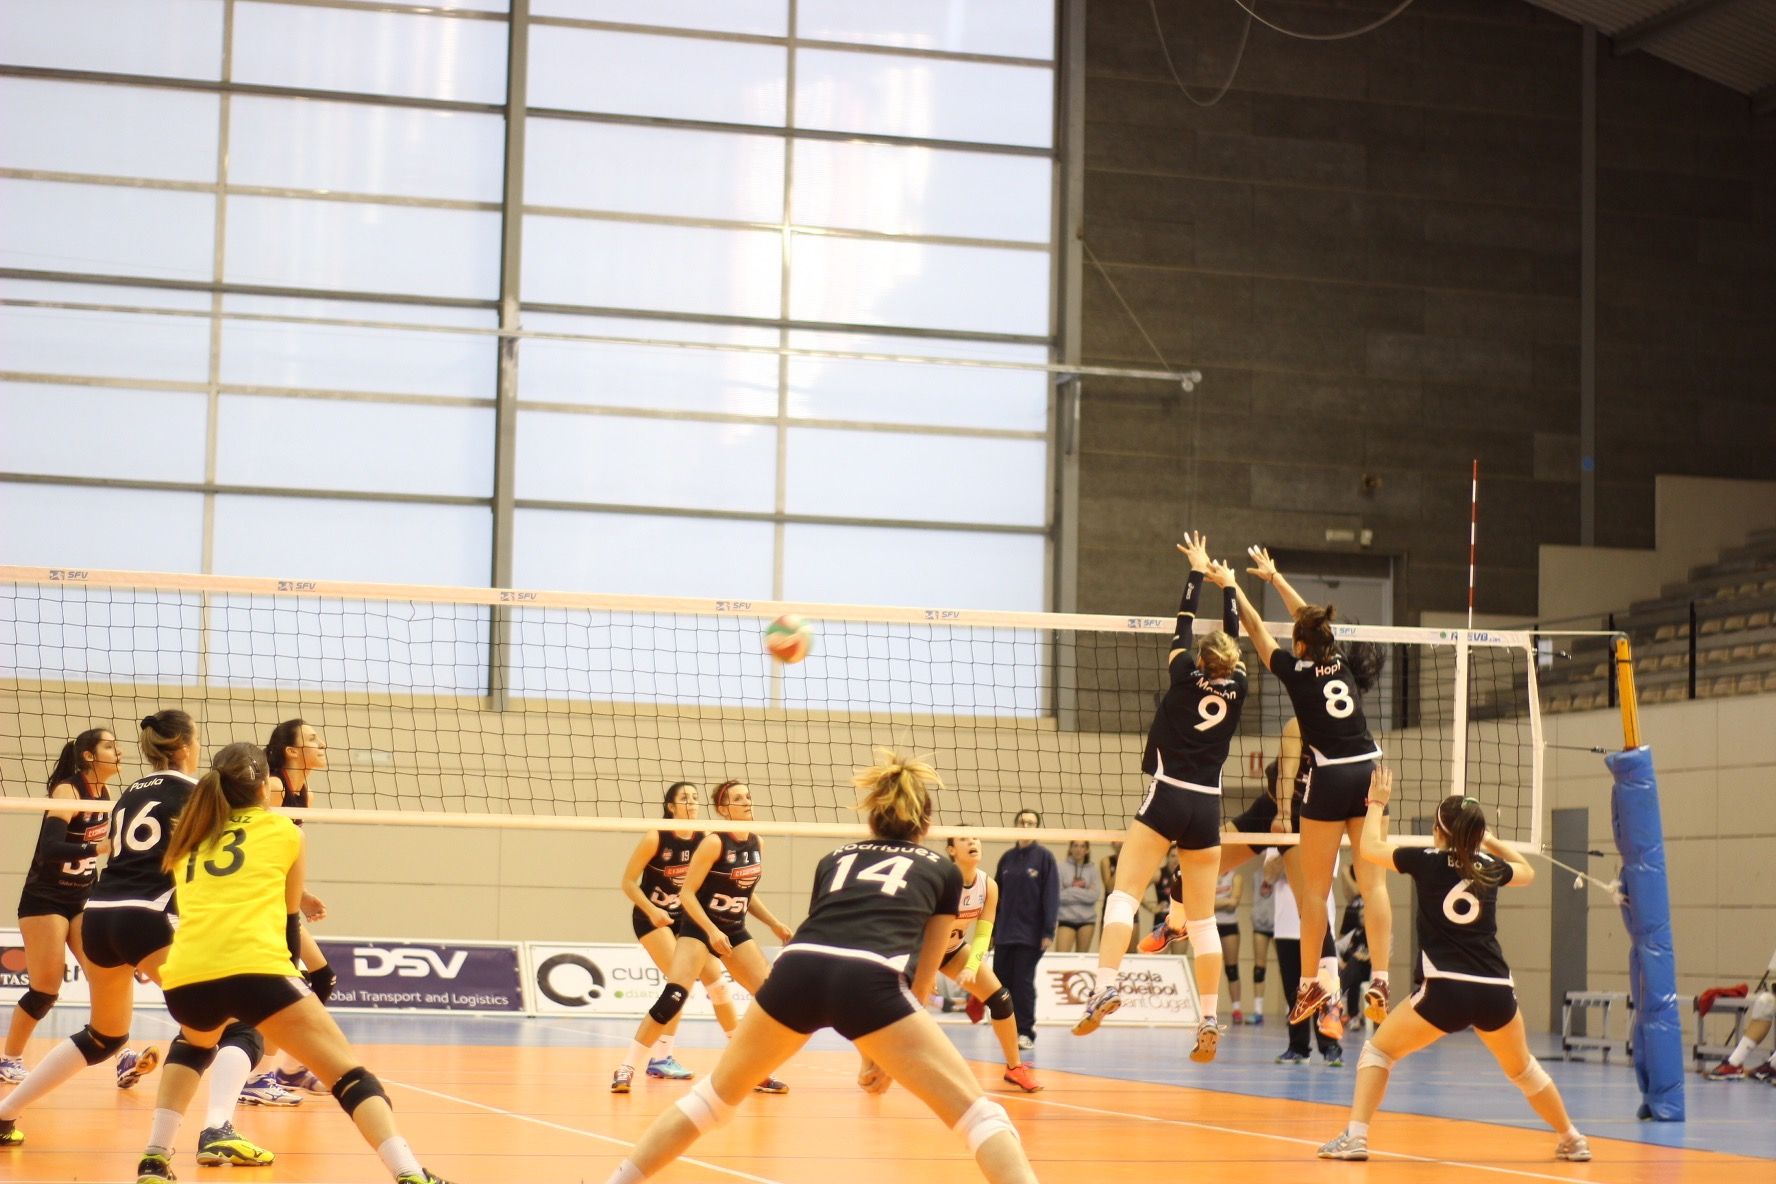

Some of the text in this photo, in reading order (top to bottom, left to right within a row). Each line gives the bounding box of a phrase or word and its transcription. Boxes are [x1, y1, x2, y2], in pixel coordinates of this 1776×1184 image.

[1193, 695, 1228, 731] 9
[1322, 679, 1354, 718] 8
[130, 778, 164, 792] Paula
[113, 801, 162, 857] 16
[186, 827, 247, 883] 13
[830, 853, 914, 896] 14
[1443, 879, 1480, 925] 6
[353, 947, 468, 979] DSV
[360, 991, 422, 1004] Transport
[425, 993, 449, 1004] and
[453, 994, 509, 1007] Logistics
